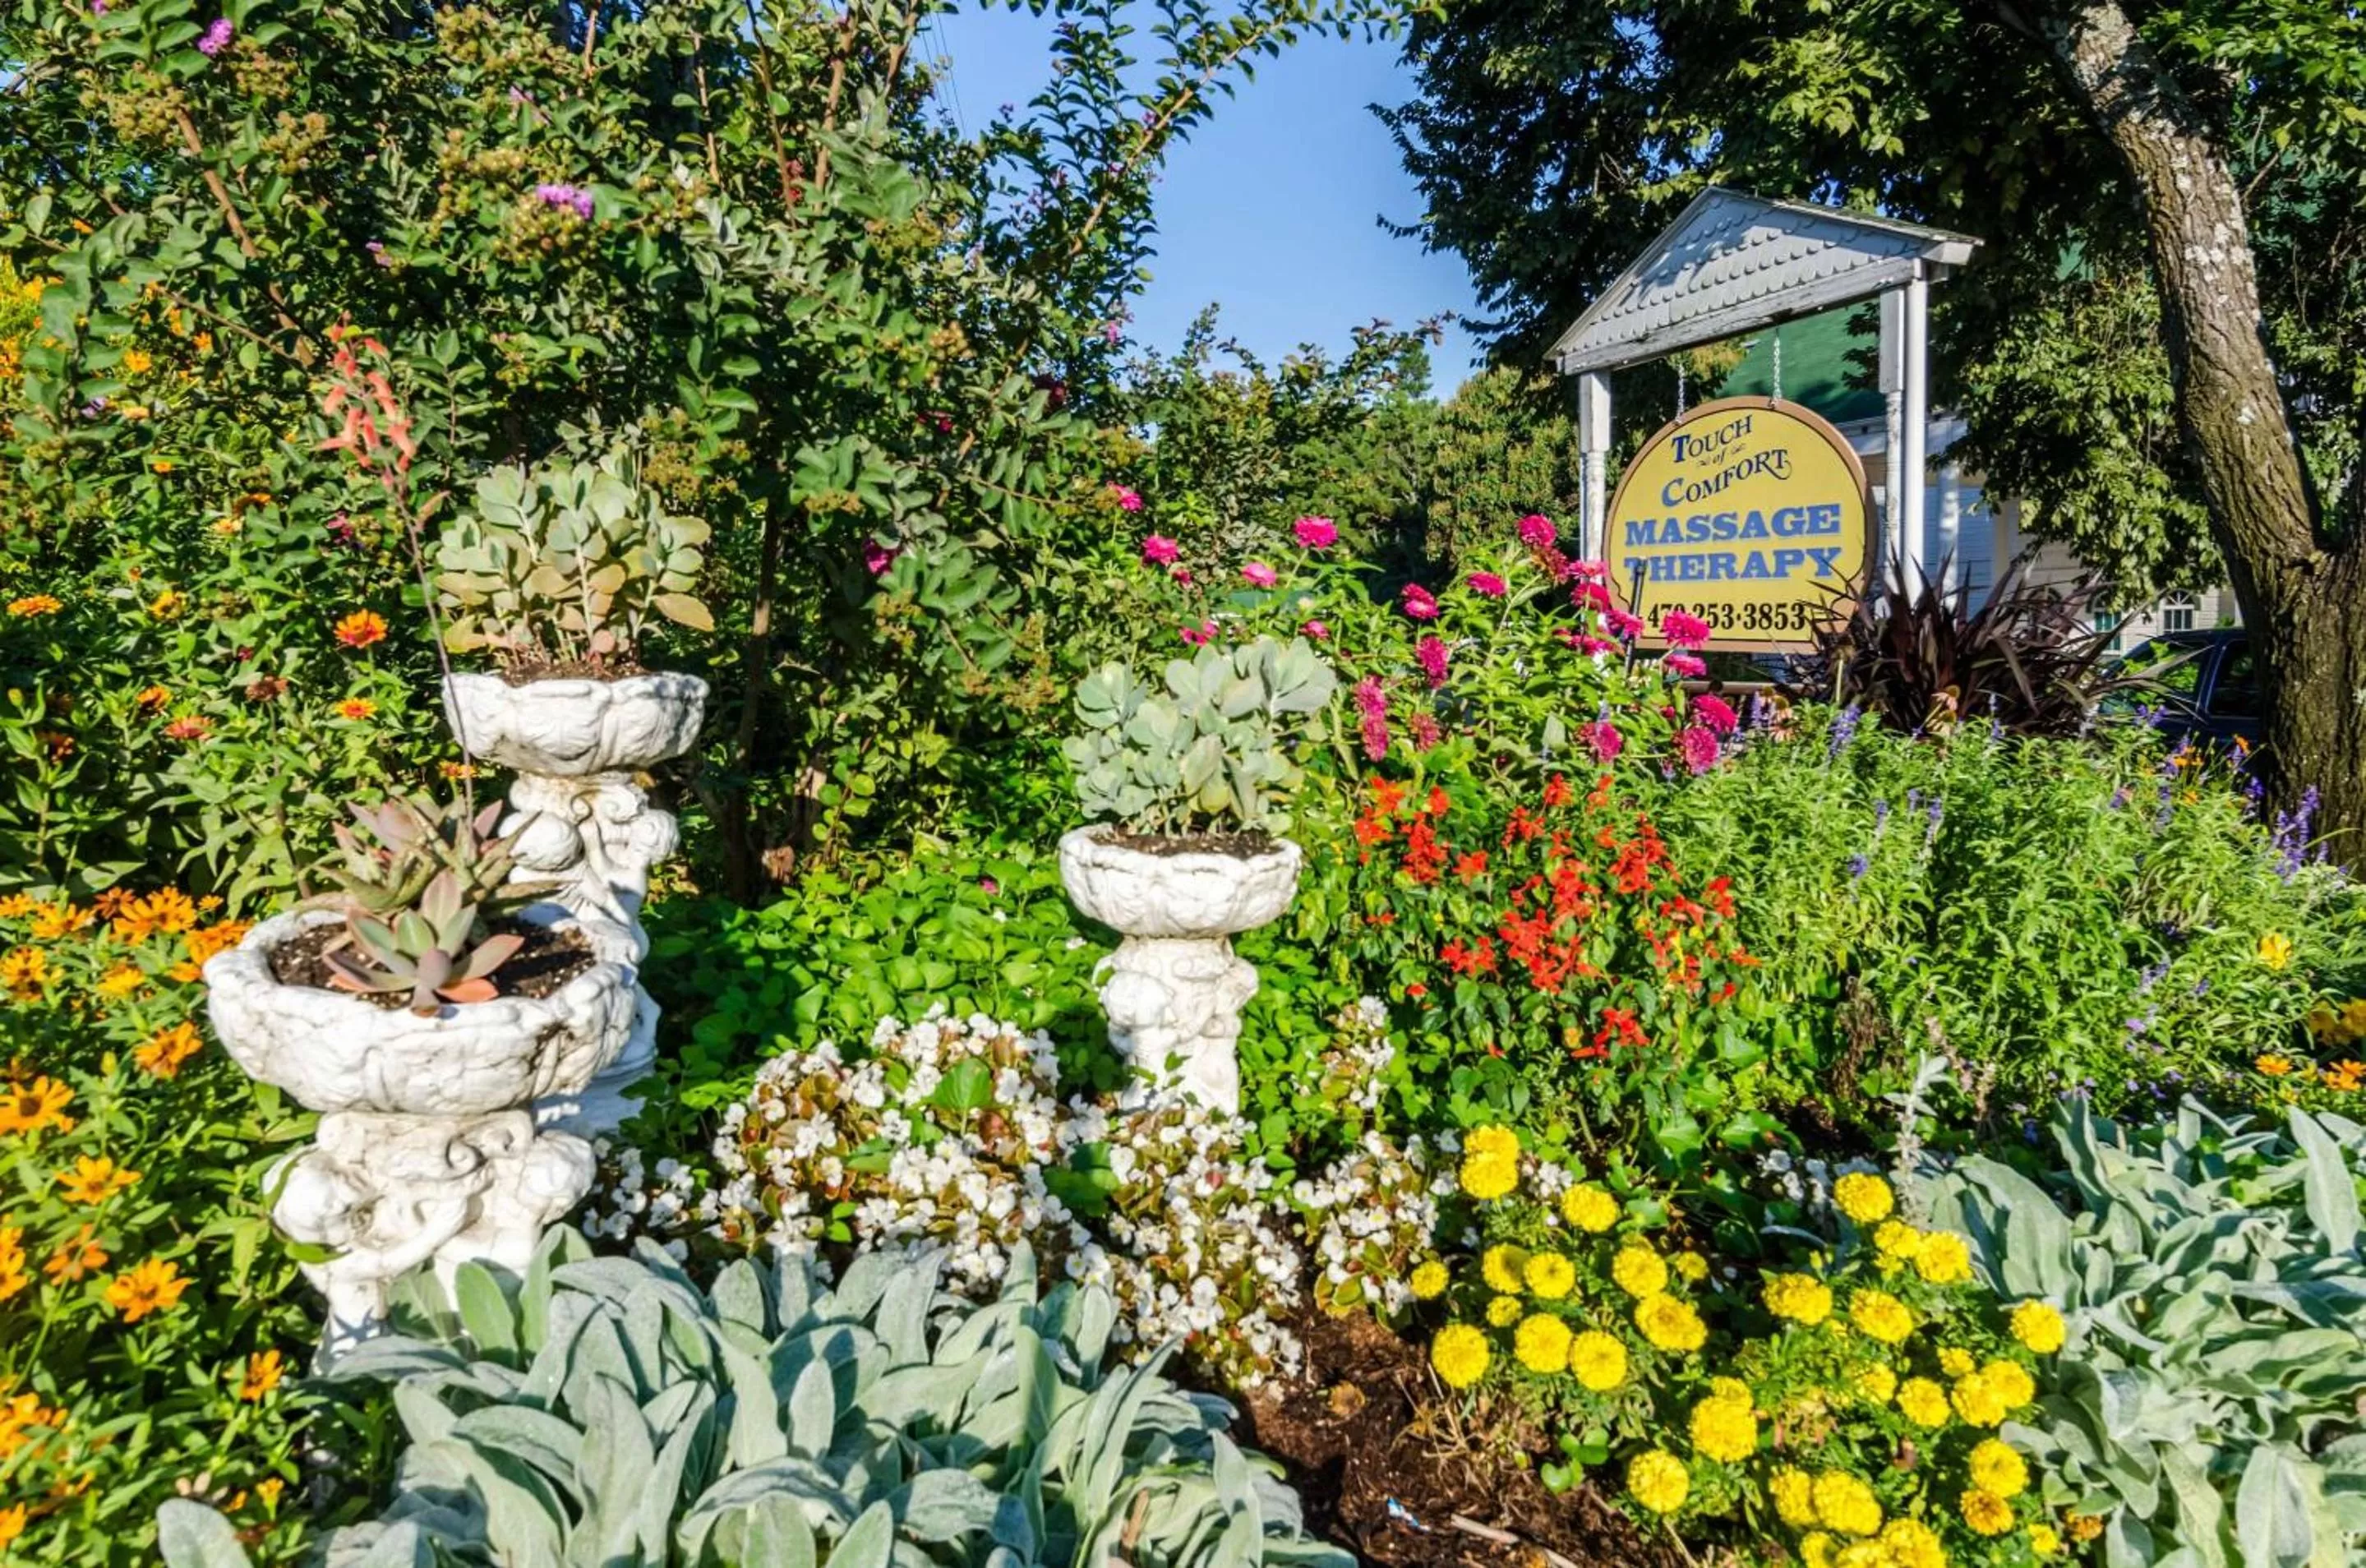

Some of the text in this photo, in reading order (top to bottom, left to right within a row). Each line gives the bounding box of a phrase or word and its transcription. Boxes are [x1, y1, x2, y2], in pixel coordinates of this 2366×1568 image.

[1672, 414, 1752, 463] TOUCH
[1712, 447, 1727, 465] of
[1661, 449, 1792, 507] COMFORT
[1625, 503, 1842, 546] MASSAGE
